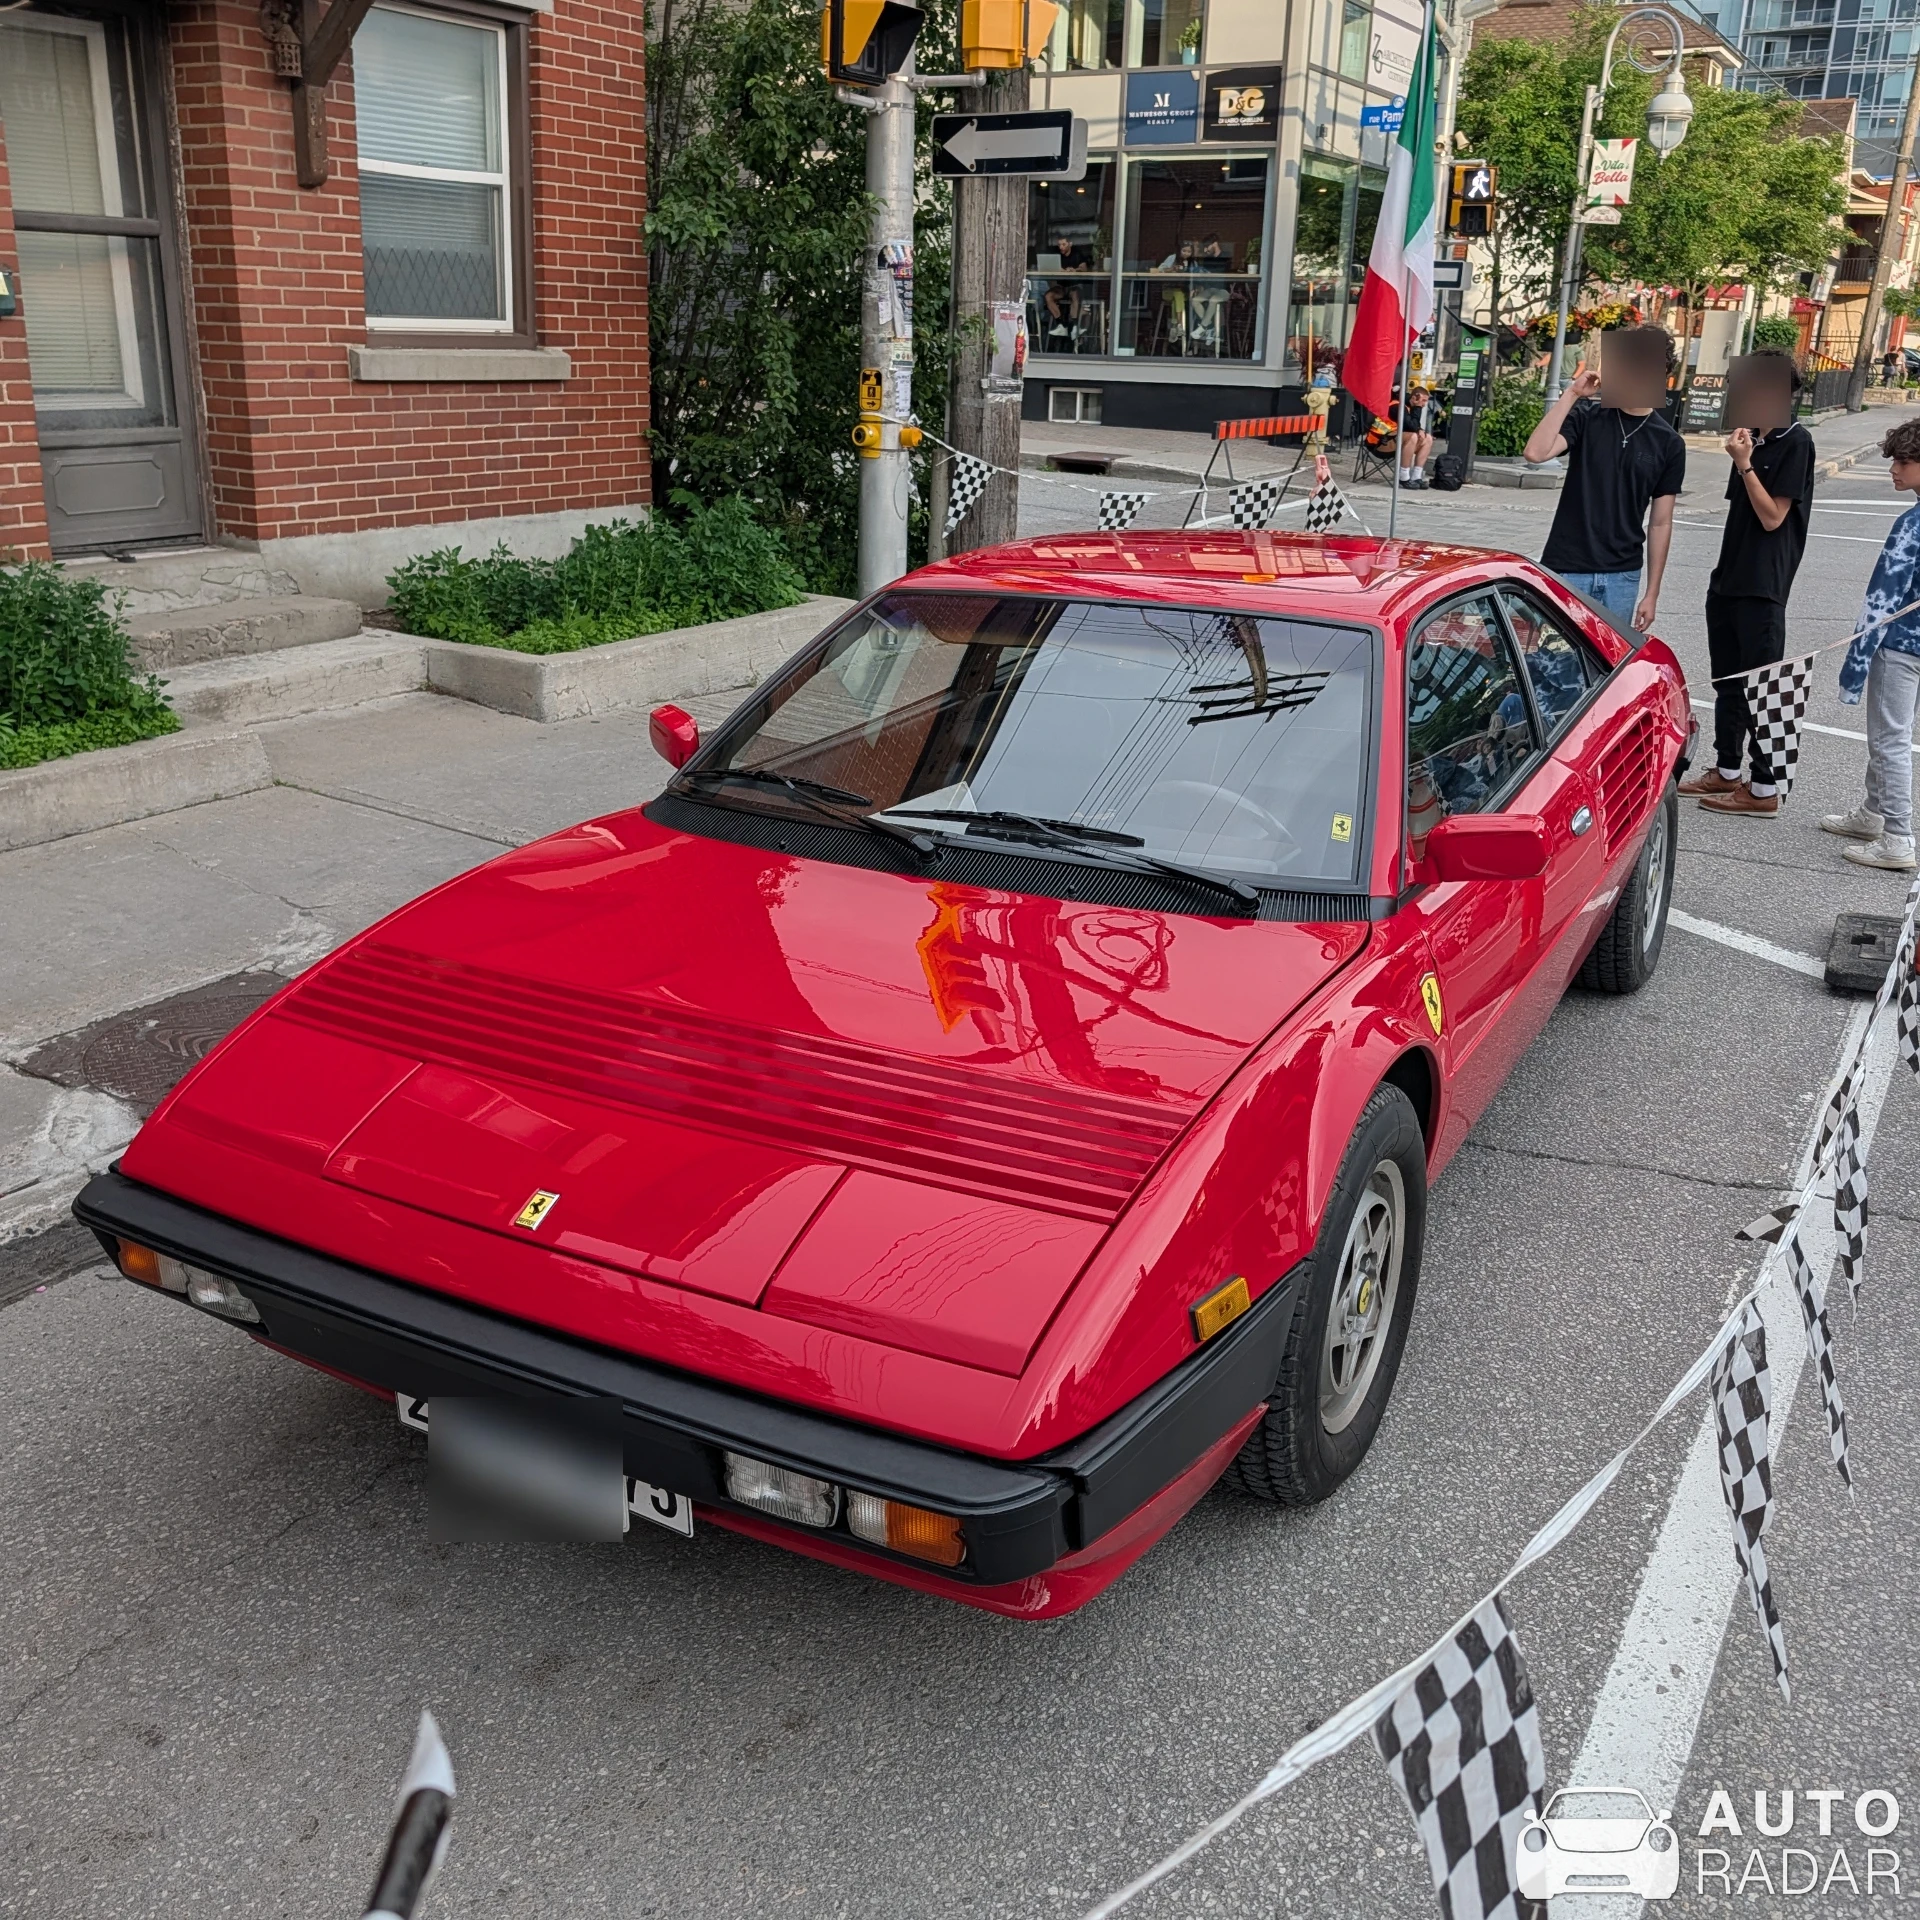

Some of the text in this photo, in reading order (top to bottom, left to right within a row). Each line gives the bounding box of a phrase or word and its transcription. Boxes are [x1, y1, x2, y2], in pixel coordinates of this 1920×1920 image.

[1153, 93, 1171, 108] M
[1219, 88, 1265, 117] D&G
[1128, 110, 1168, 118] MATHESON
[1382, 110, 1405, 122] Pami
[1600, 160, 1625, 171] Vita
[1592, 171, 1629, 185] Bella
[1693, 376, 1724, 388] OPEN
